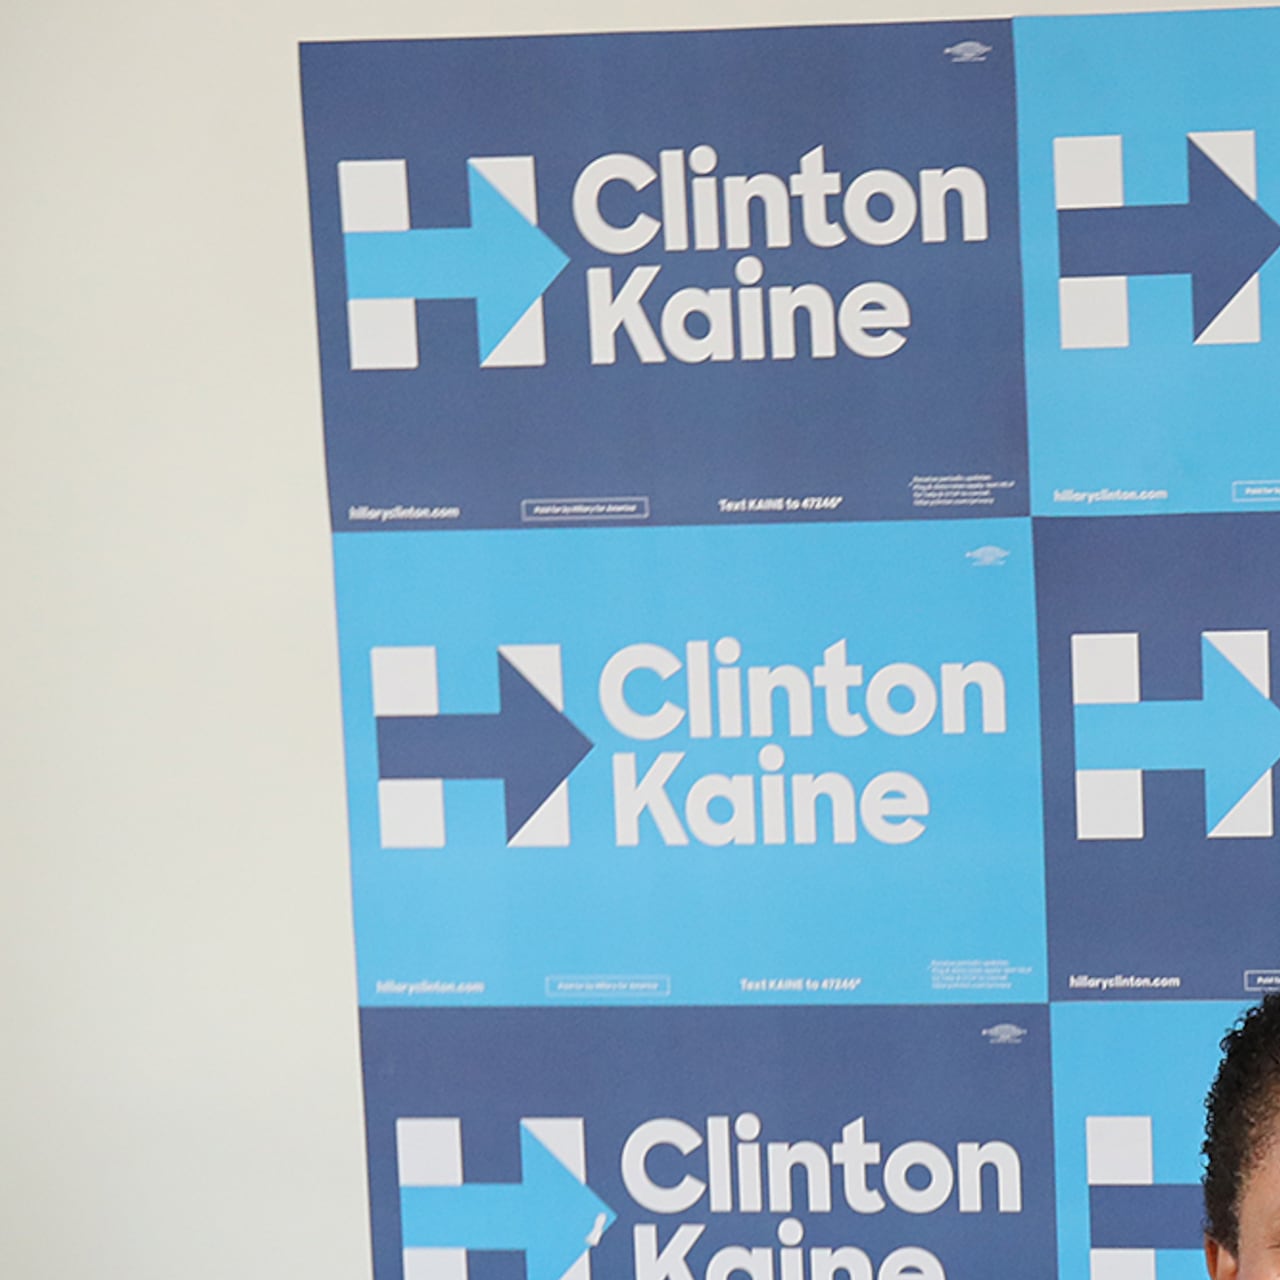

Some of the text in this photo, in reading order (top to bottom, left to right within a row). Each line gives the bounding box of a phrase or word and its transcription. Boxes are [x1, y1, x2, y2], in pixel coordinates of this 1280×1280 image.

[573, 146, 987, 254] Clinton
[587, 256, 910, 364] Kaine
[599, 637, 1006, 740] Clinton
[612, 744, 930, 847] Kaine
[1069, 974, 1180, 990] hillaryclinton.com
[622, 1117, 1021, 1213] Clinton
